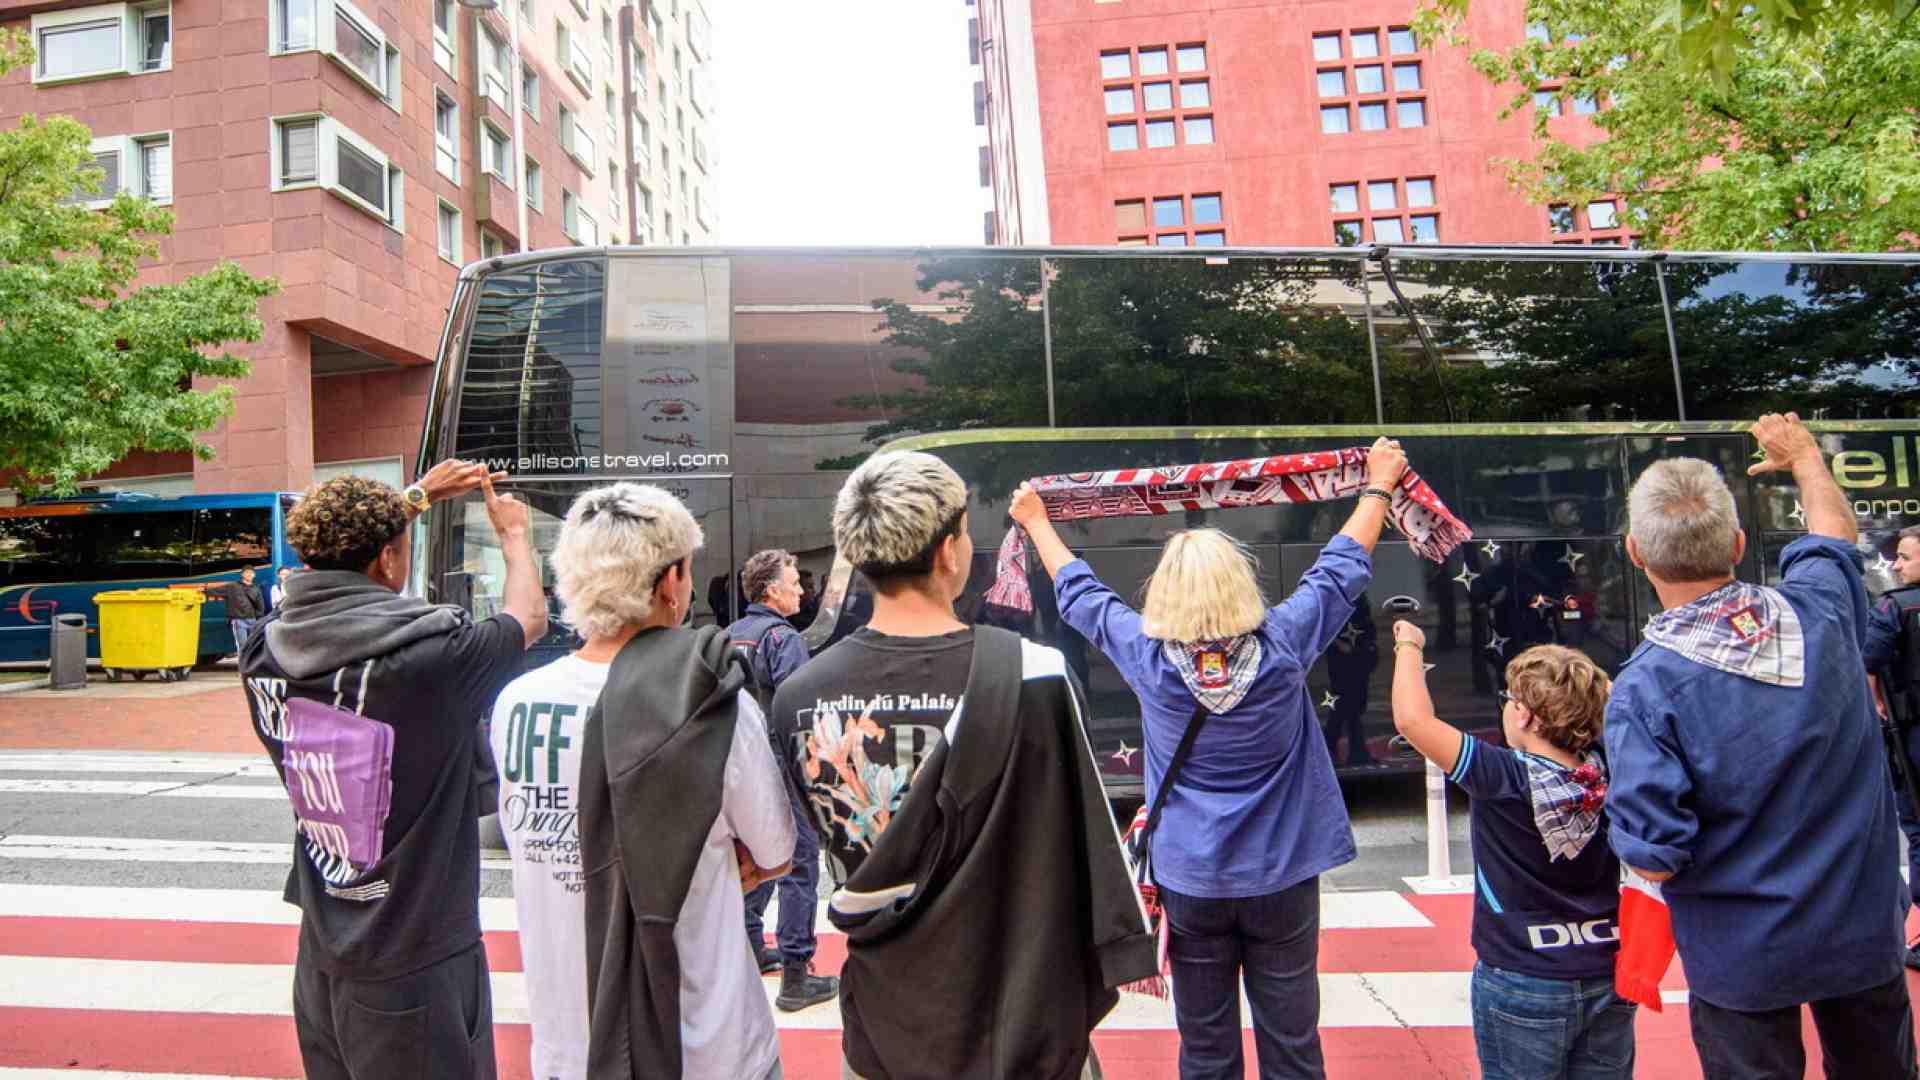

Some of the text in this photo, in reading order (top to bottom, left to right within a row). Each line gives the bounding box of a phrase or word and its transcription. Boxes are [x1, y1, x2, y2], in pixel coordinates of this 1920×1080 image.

[464, 451, 729, 470] w.ellisonstravel.com
[1850, 498, 1920, 520] orpo
[815, 693, 866, 713] Jardin
[897, 692, 956, 711] Palais
[504, 702, 578, 783] OFF
[521, 786, 569, 809] THE
